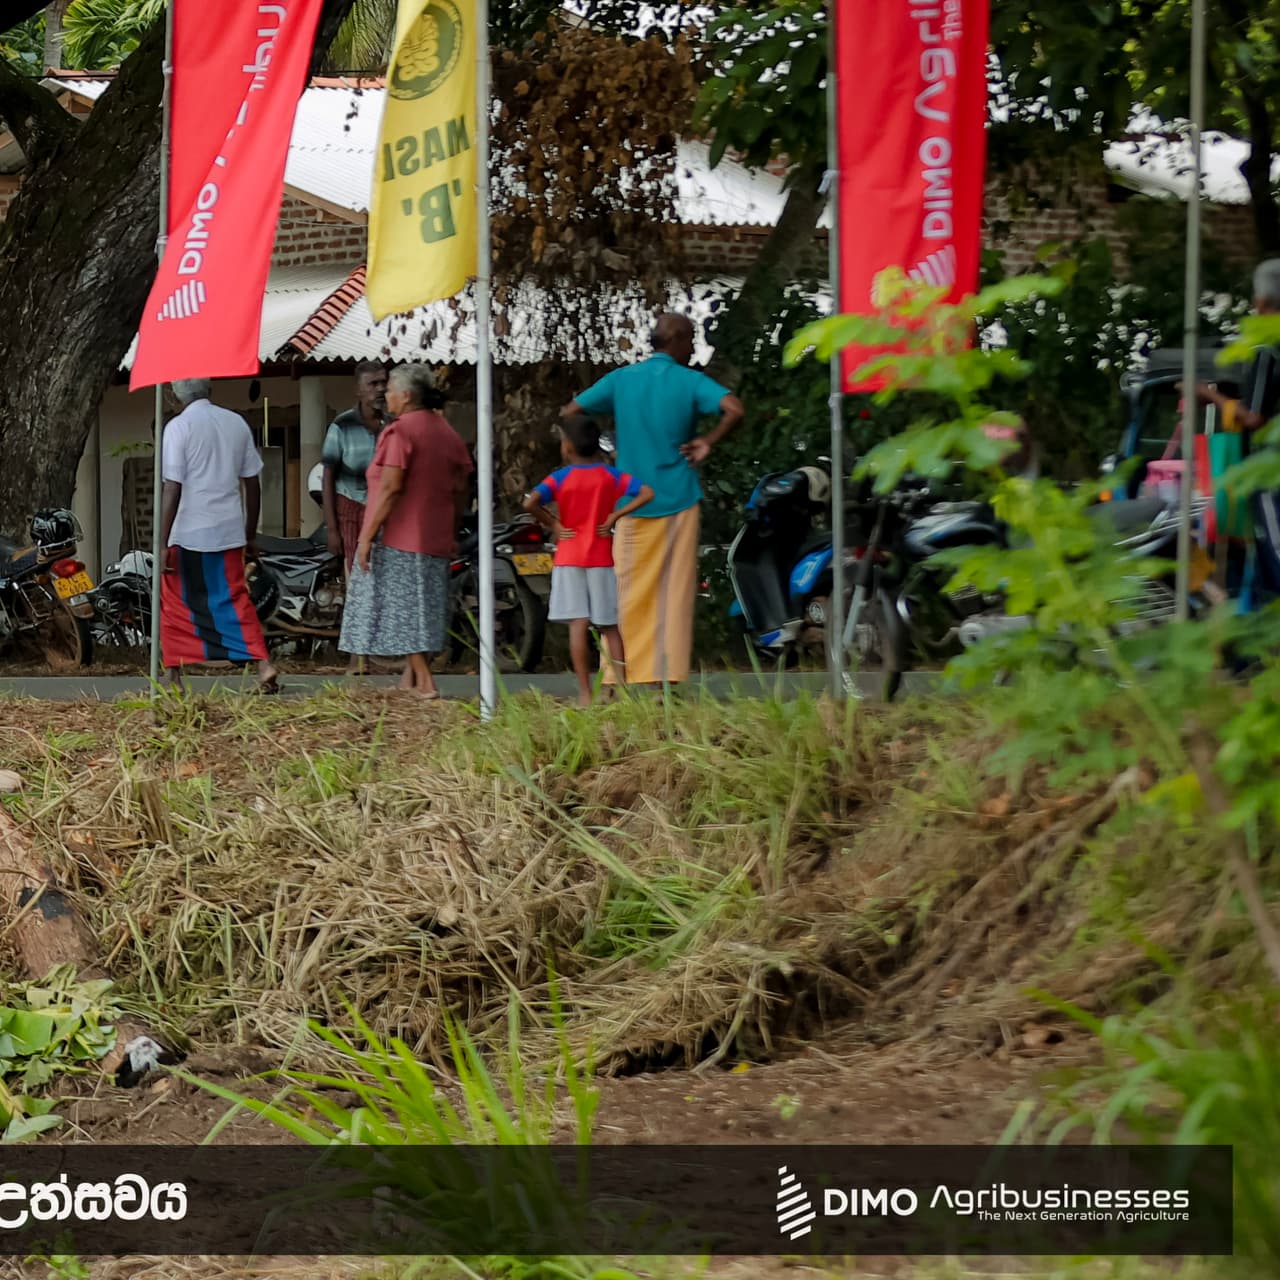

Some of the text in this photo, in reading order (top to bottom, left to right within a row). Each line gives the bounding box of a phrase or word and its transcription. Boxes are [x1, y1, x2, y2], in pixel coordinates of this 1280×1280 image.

[941, 0, 964, 40] The
[178, 183, 219, 275] DIMO
[919, 136, 953, 239] DIMO
